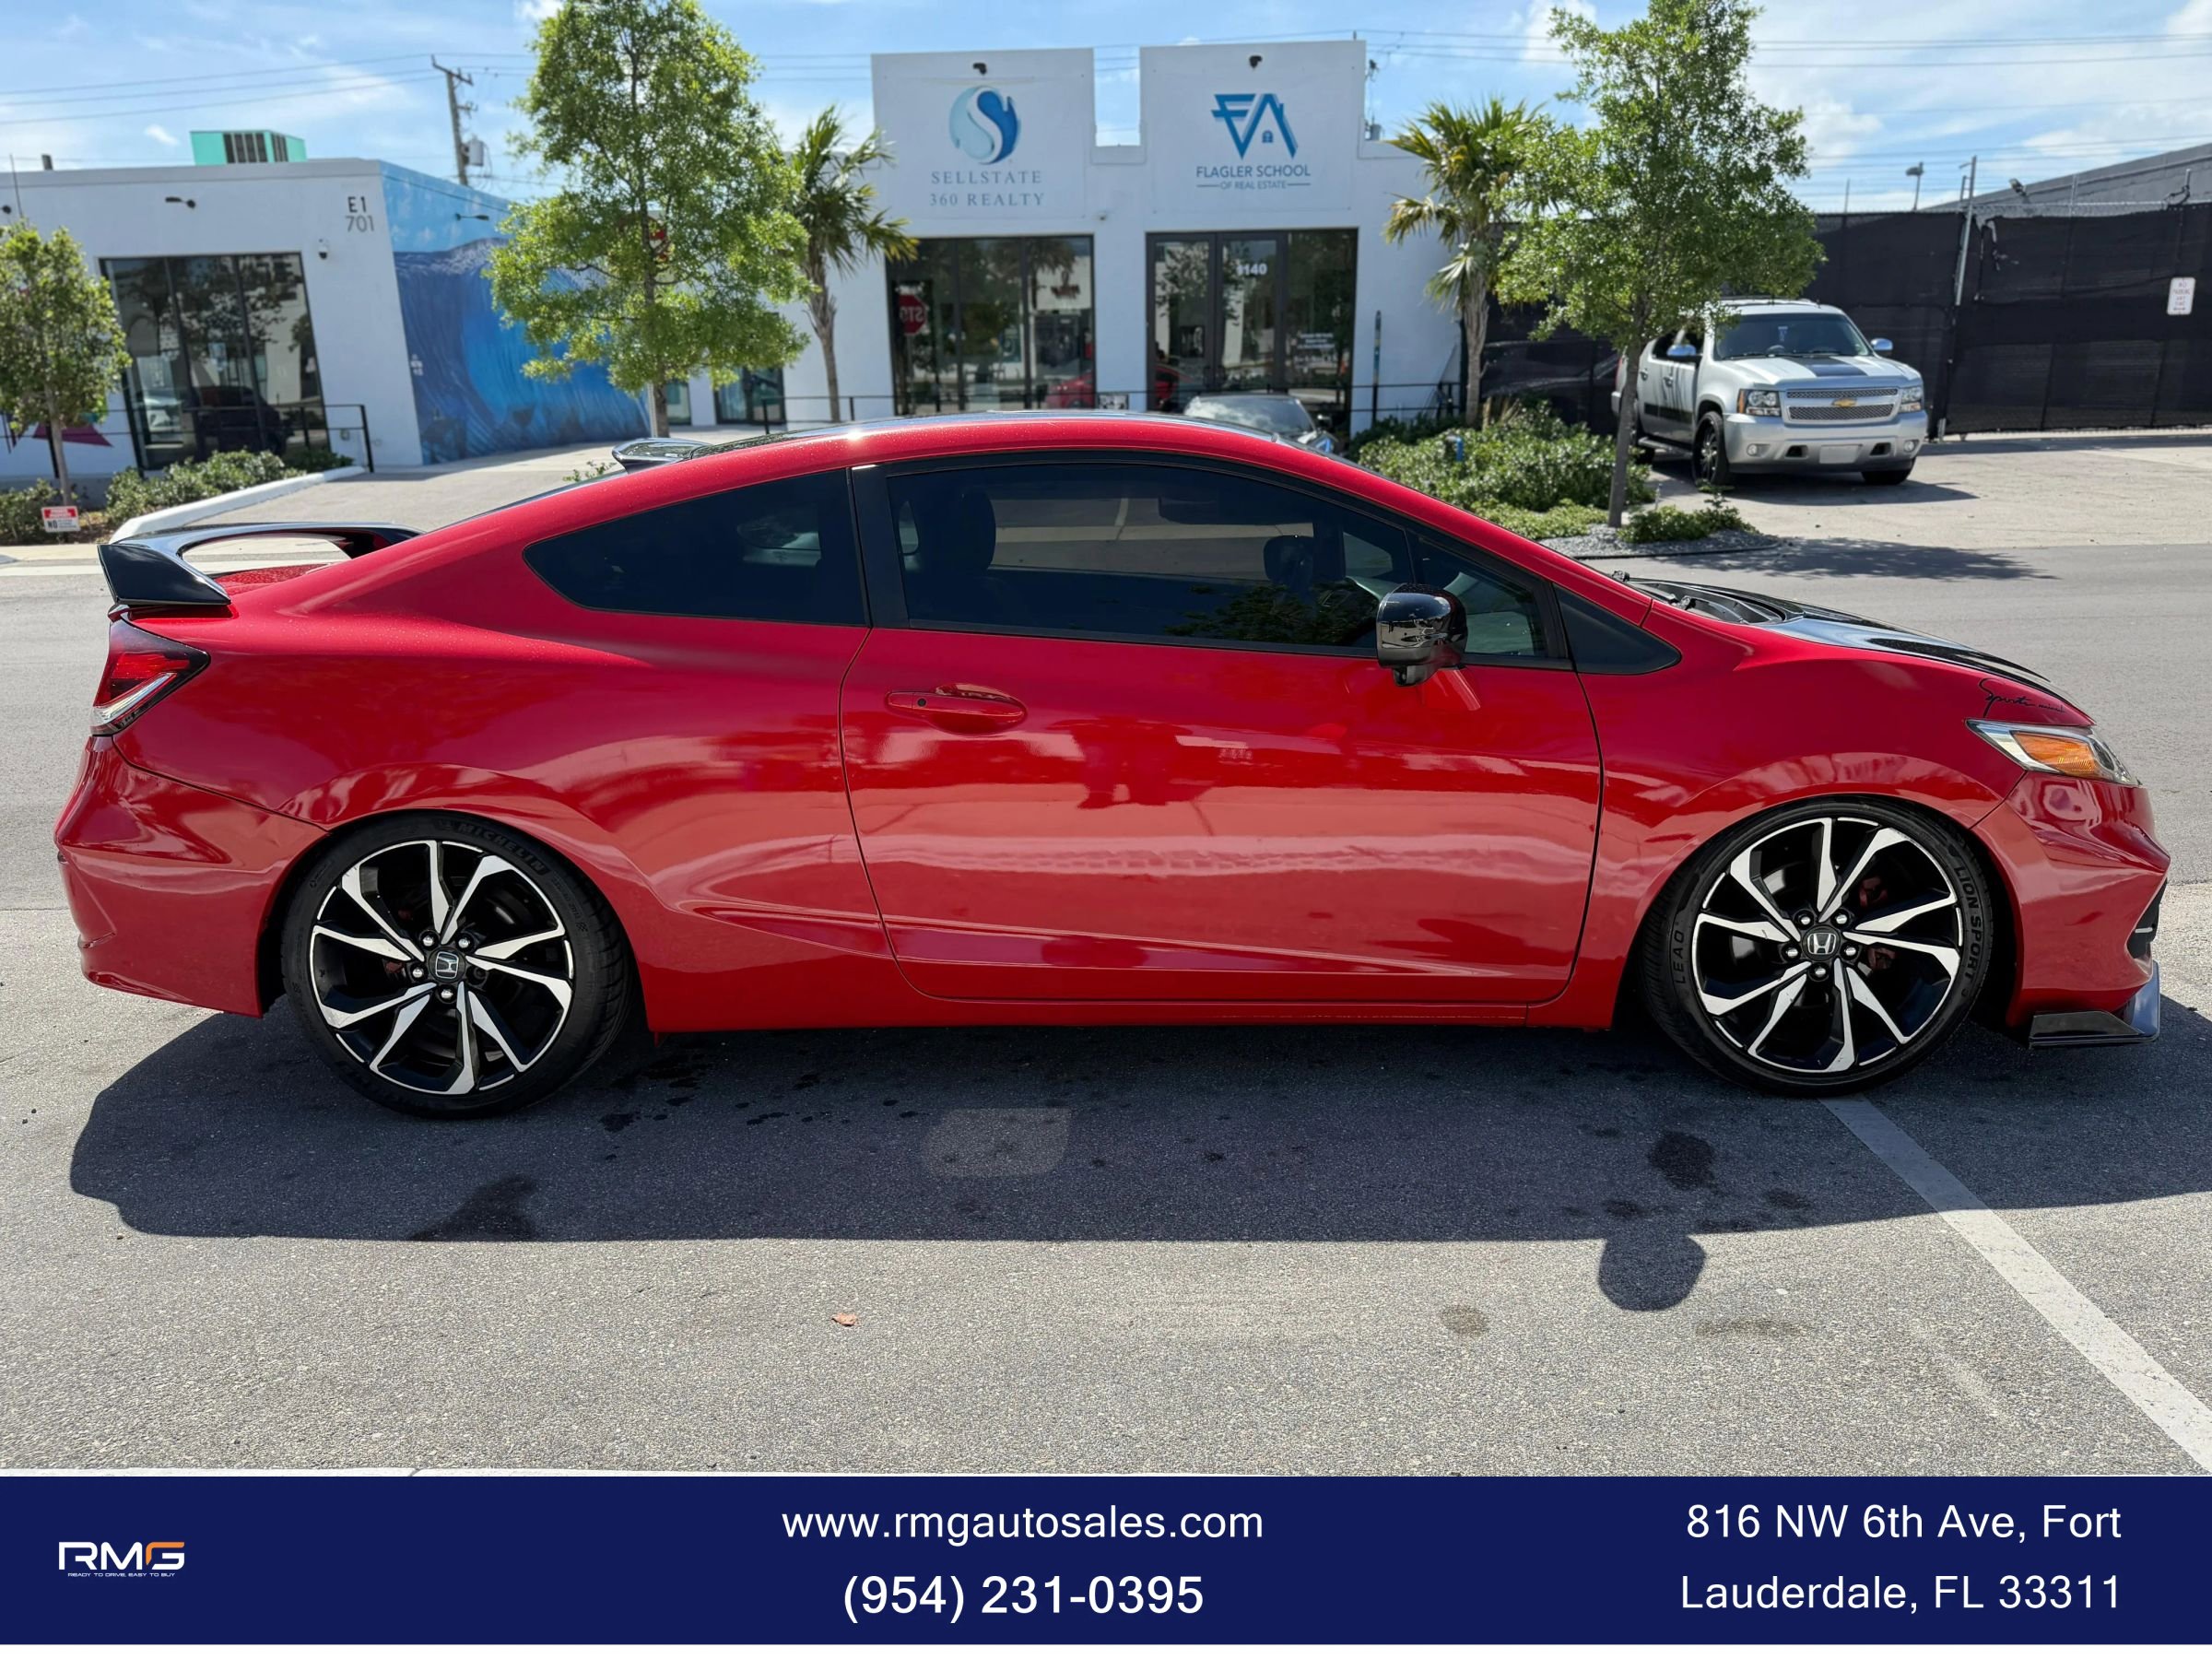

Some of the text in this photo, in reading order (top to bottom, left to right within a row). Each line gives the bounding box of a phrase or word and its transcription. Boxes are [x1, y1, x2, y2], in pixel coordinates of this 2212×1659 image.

[930, 170, 1042, 184] SELLSTATE
[1195, 164, 1312, 178] FLAGLER SCHOOL
[1220, 180, 1287, 190] OF REAL ESTATE
[929, 192, 1044, 206] 360 REALTY
[345, 215, 374, 232] 701
[458, 822, 545, 872] MICHELIN
[1955, 865, 1981, 910] LION
[1673, 929, 1686, 984] LEAO
[1965, 915, 1983, 981] SPORT
